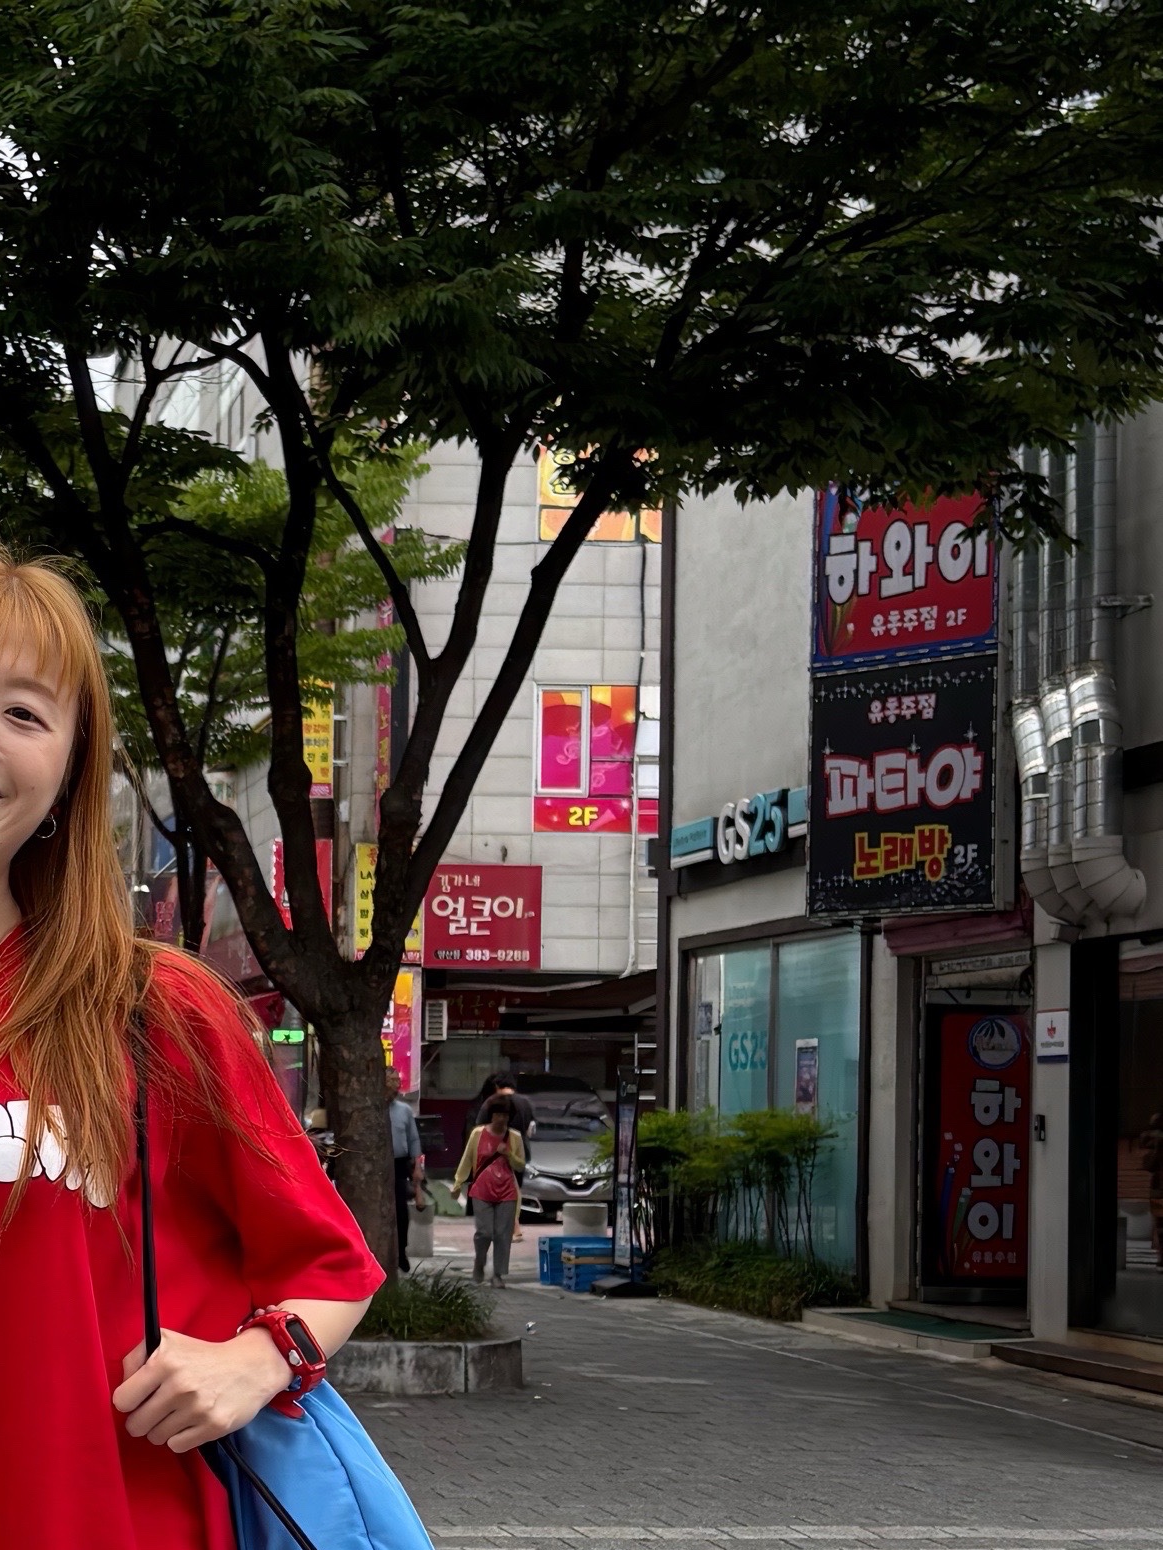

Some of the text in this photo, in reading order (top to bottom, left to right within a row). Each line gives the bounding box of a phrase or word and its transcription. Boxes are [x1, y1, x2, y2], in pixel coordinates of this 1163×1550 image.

[825, 520, 988, 604] 하와이
[871, 605, 967, 637] 유흥주점 2F
[824, 743, 984, 819] 파타야
[568, 806, 599, 826] 2F
[718, 788, 783, 865] GS25
[854, 824, 978, 881] 노래방 2F
[431, 895, 524, 936] 얼큰이
[967, 1079, 1021, 1241] 하와이
